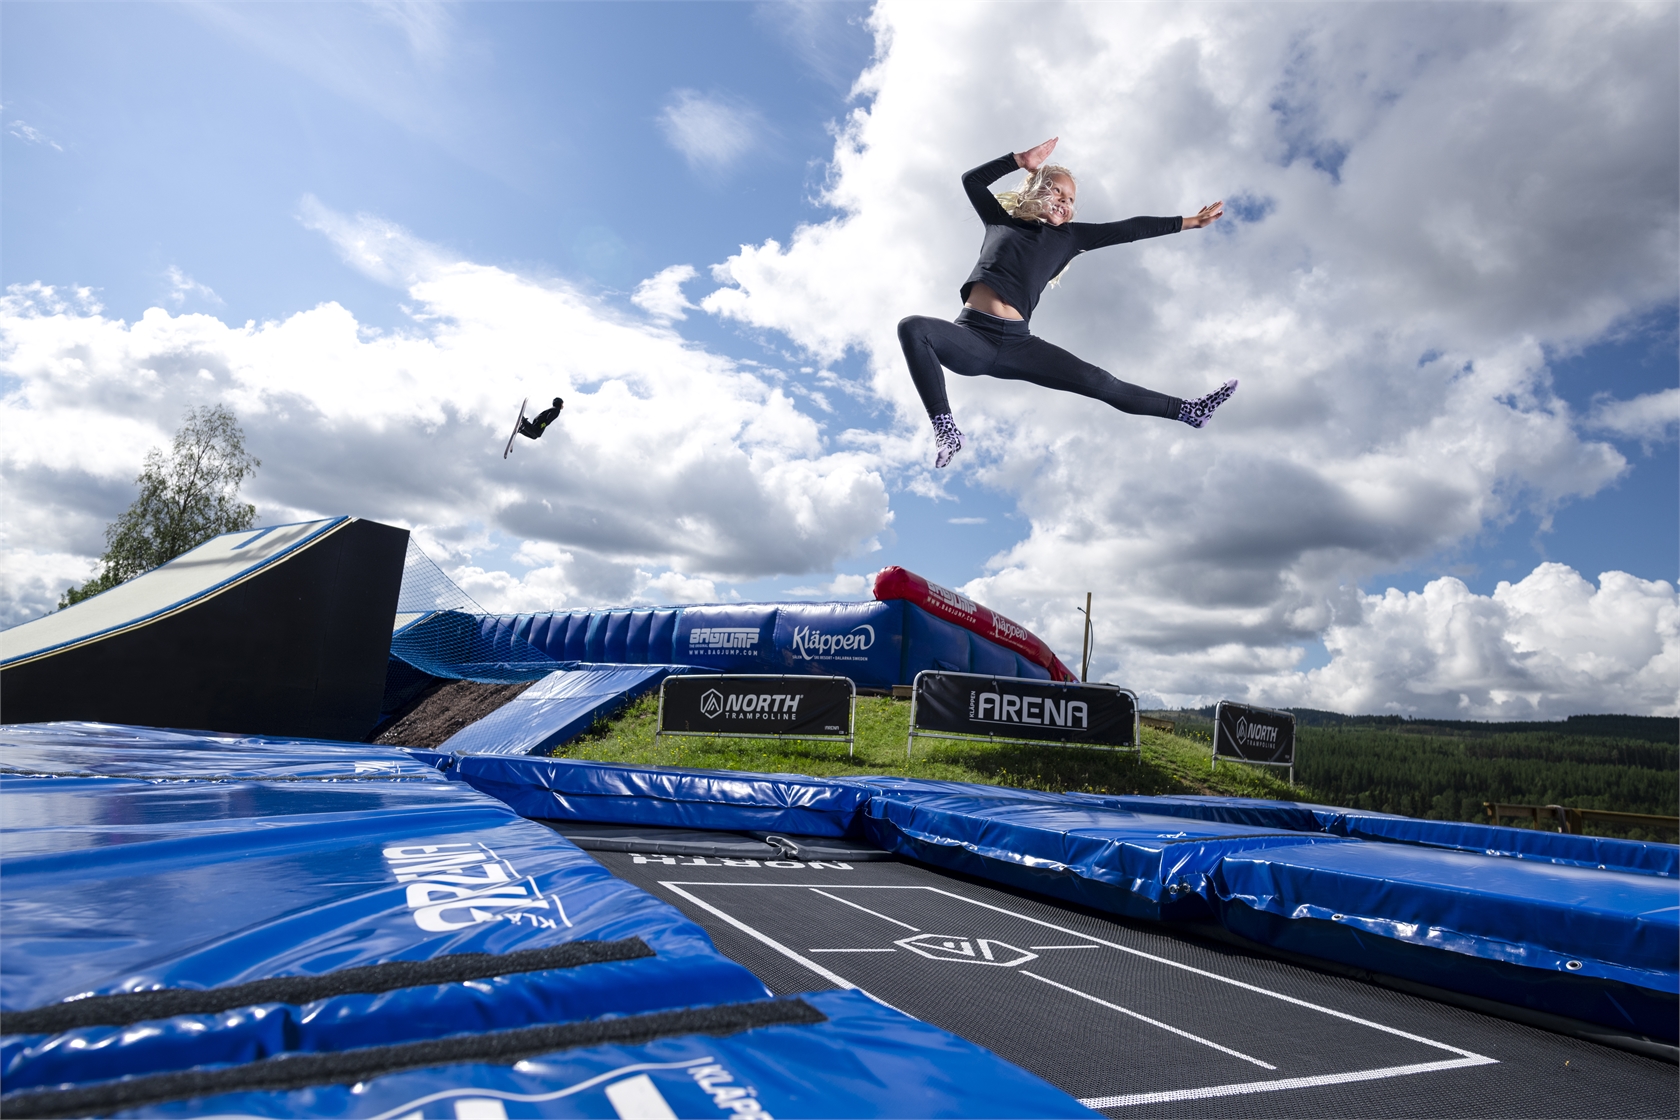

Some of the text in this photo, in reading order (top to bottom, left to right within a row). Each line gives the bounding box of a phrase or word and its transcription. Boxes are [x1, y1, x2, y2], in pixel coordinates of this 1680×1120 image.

[926, 595, 977, 624] WWW.BAGJUMP.COM
[990, 610, 1028, 641] Kläppen
[689, 627, 760, 649] BAGJUMP
[792, 624, 875, 661] Kläppen
[725, 694, 800, 712] NORTH
[968, 690, 976, 718] KLÄPPEN
[978, 692, 1088, 728] ARENA
[725, 712, 797, 720] TRAMPOLINE
[1247, 722, 1278, 743] NORTH
[1246, 739, 1276, 750] TRAMPOLINE
[632, 856, 854, 870] NORTH
